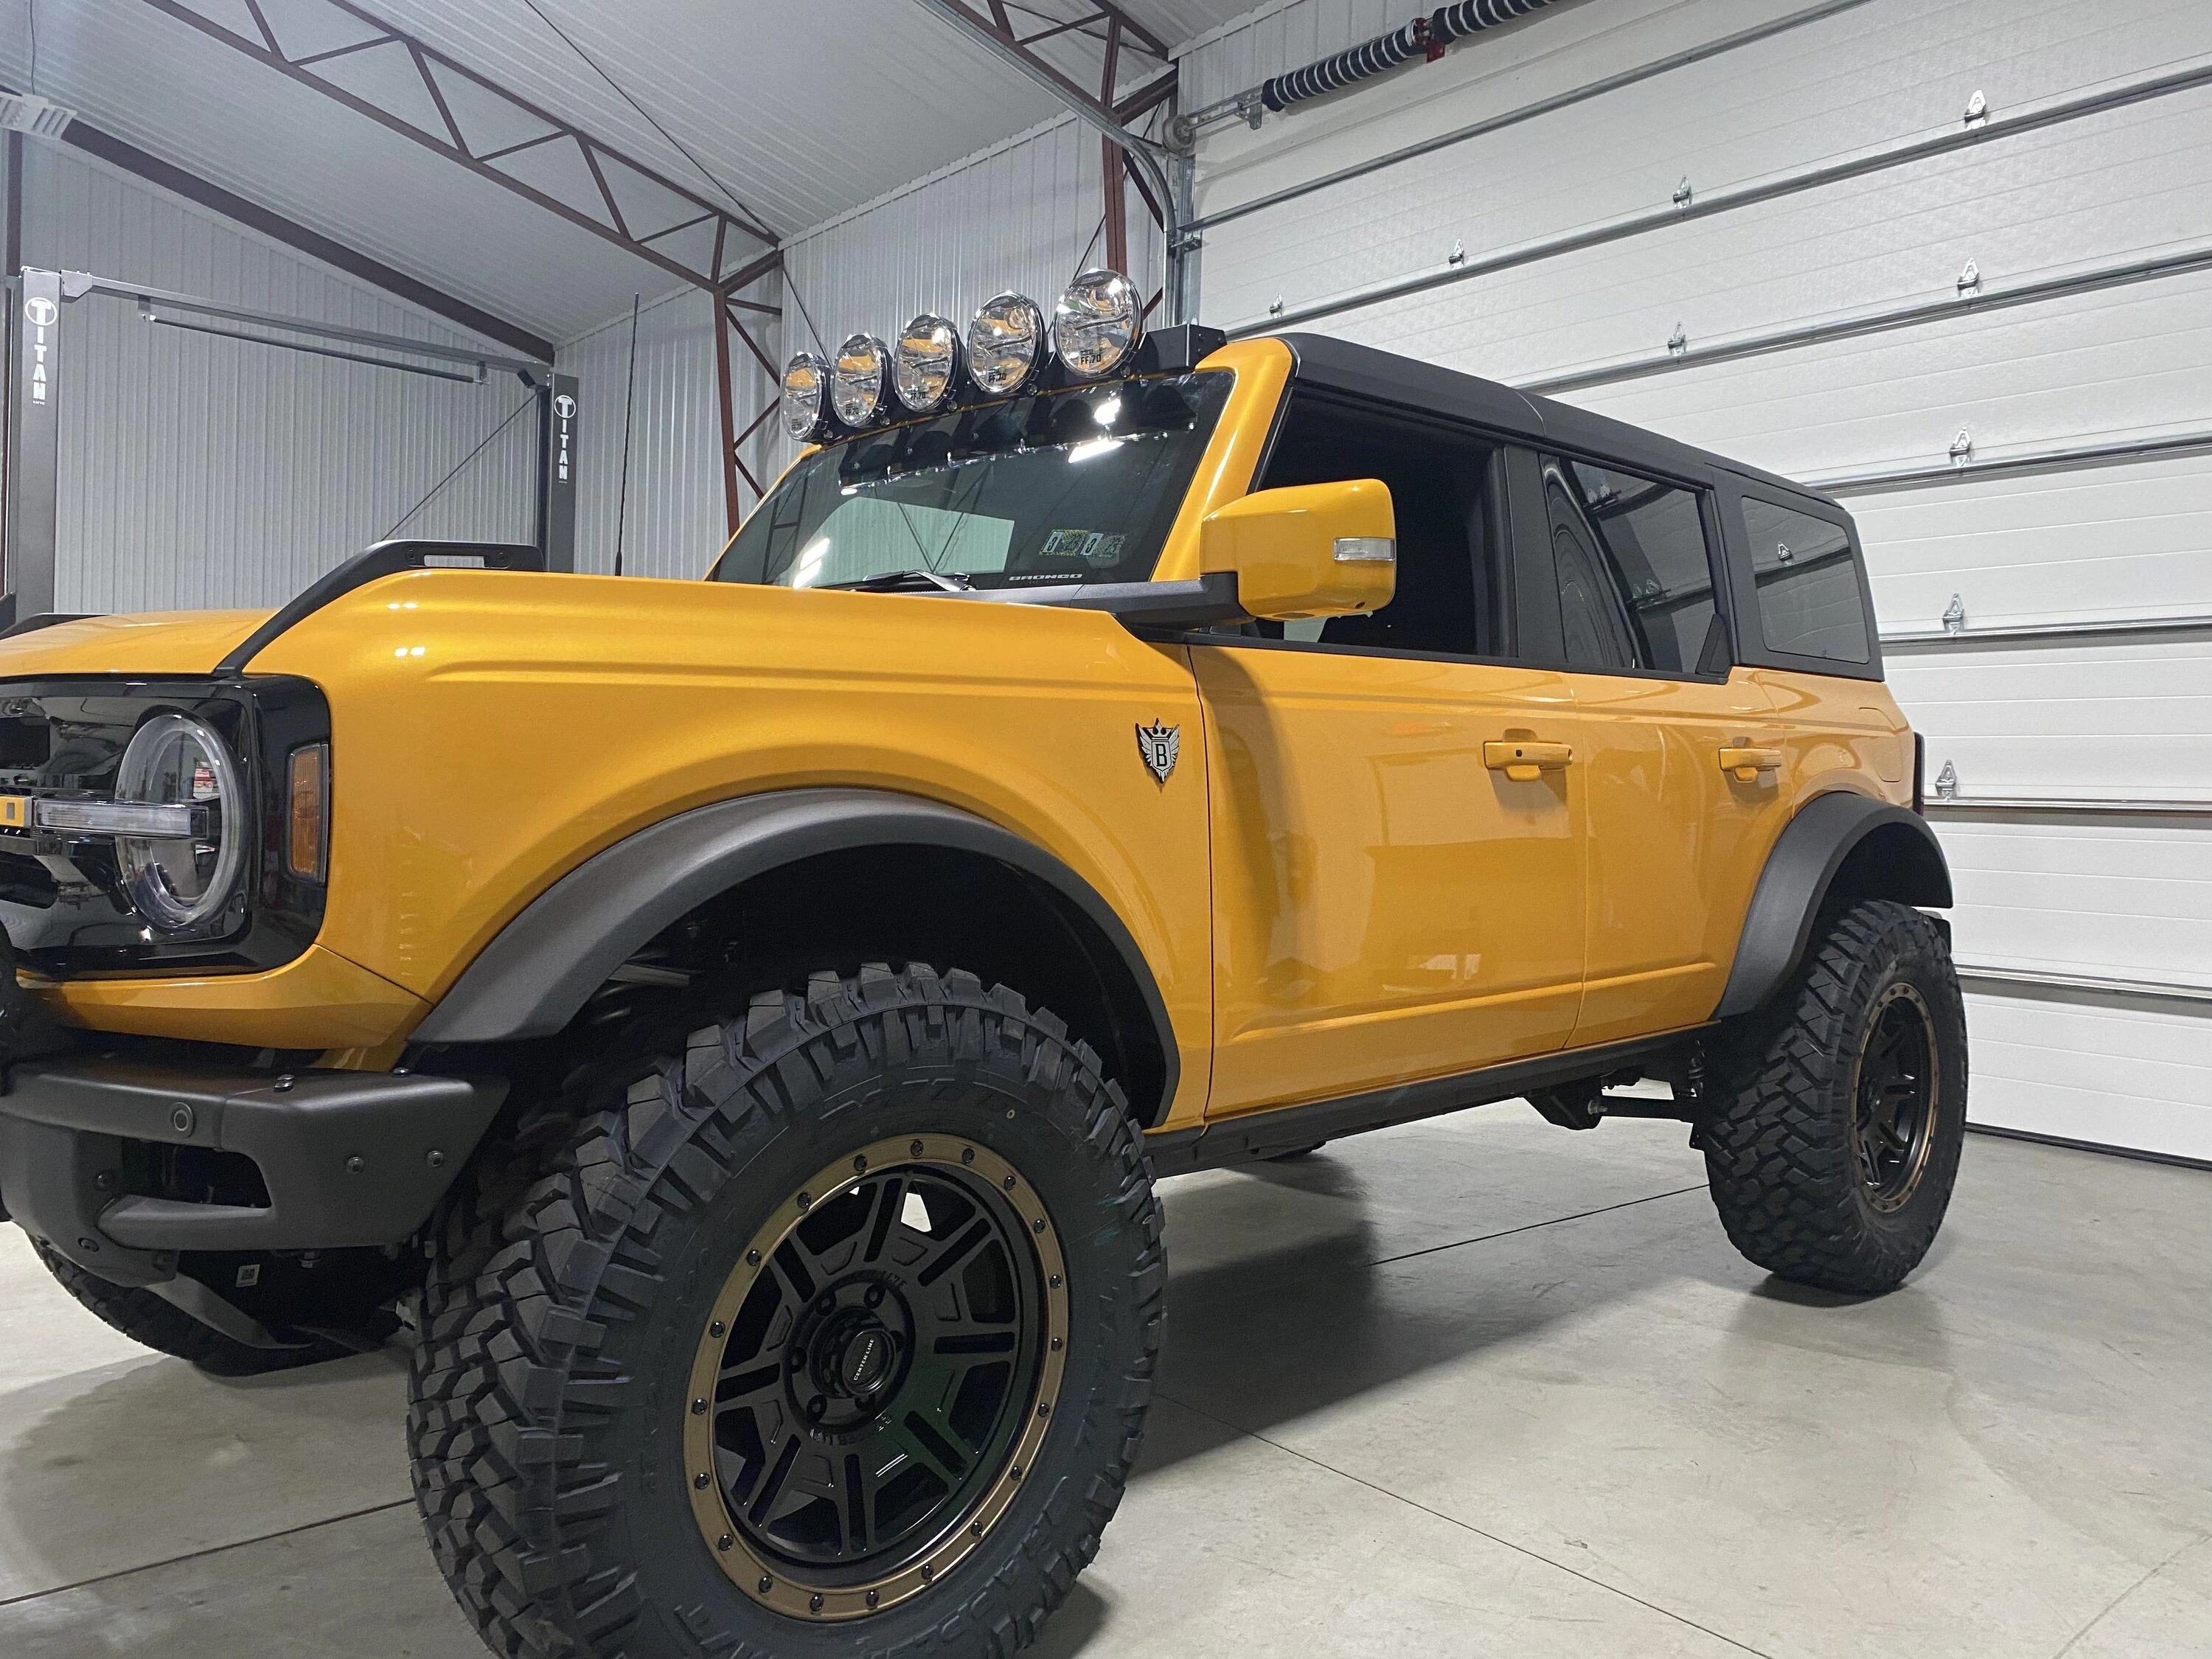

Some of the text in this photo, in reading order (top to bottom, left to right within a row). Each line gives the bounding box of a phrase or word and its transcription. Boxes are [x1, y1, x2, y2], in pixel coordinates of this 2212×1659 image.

[26, 297, 57, 400] TITAN
[1080, 354, 1102, 365] FF.70
[554, 395, 576, 480] TITAN
[1047, 536, 1059, 552] 3
[1085, 538, 1098, 554] 3
[1155, 743, 1168, 767] B
